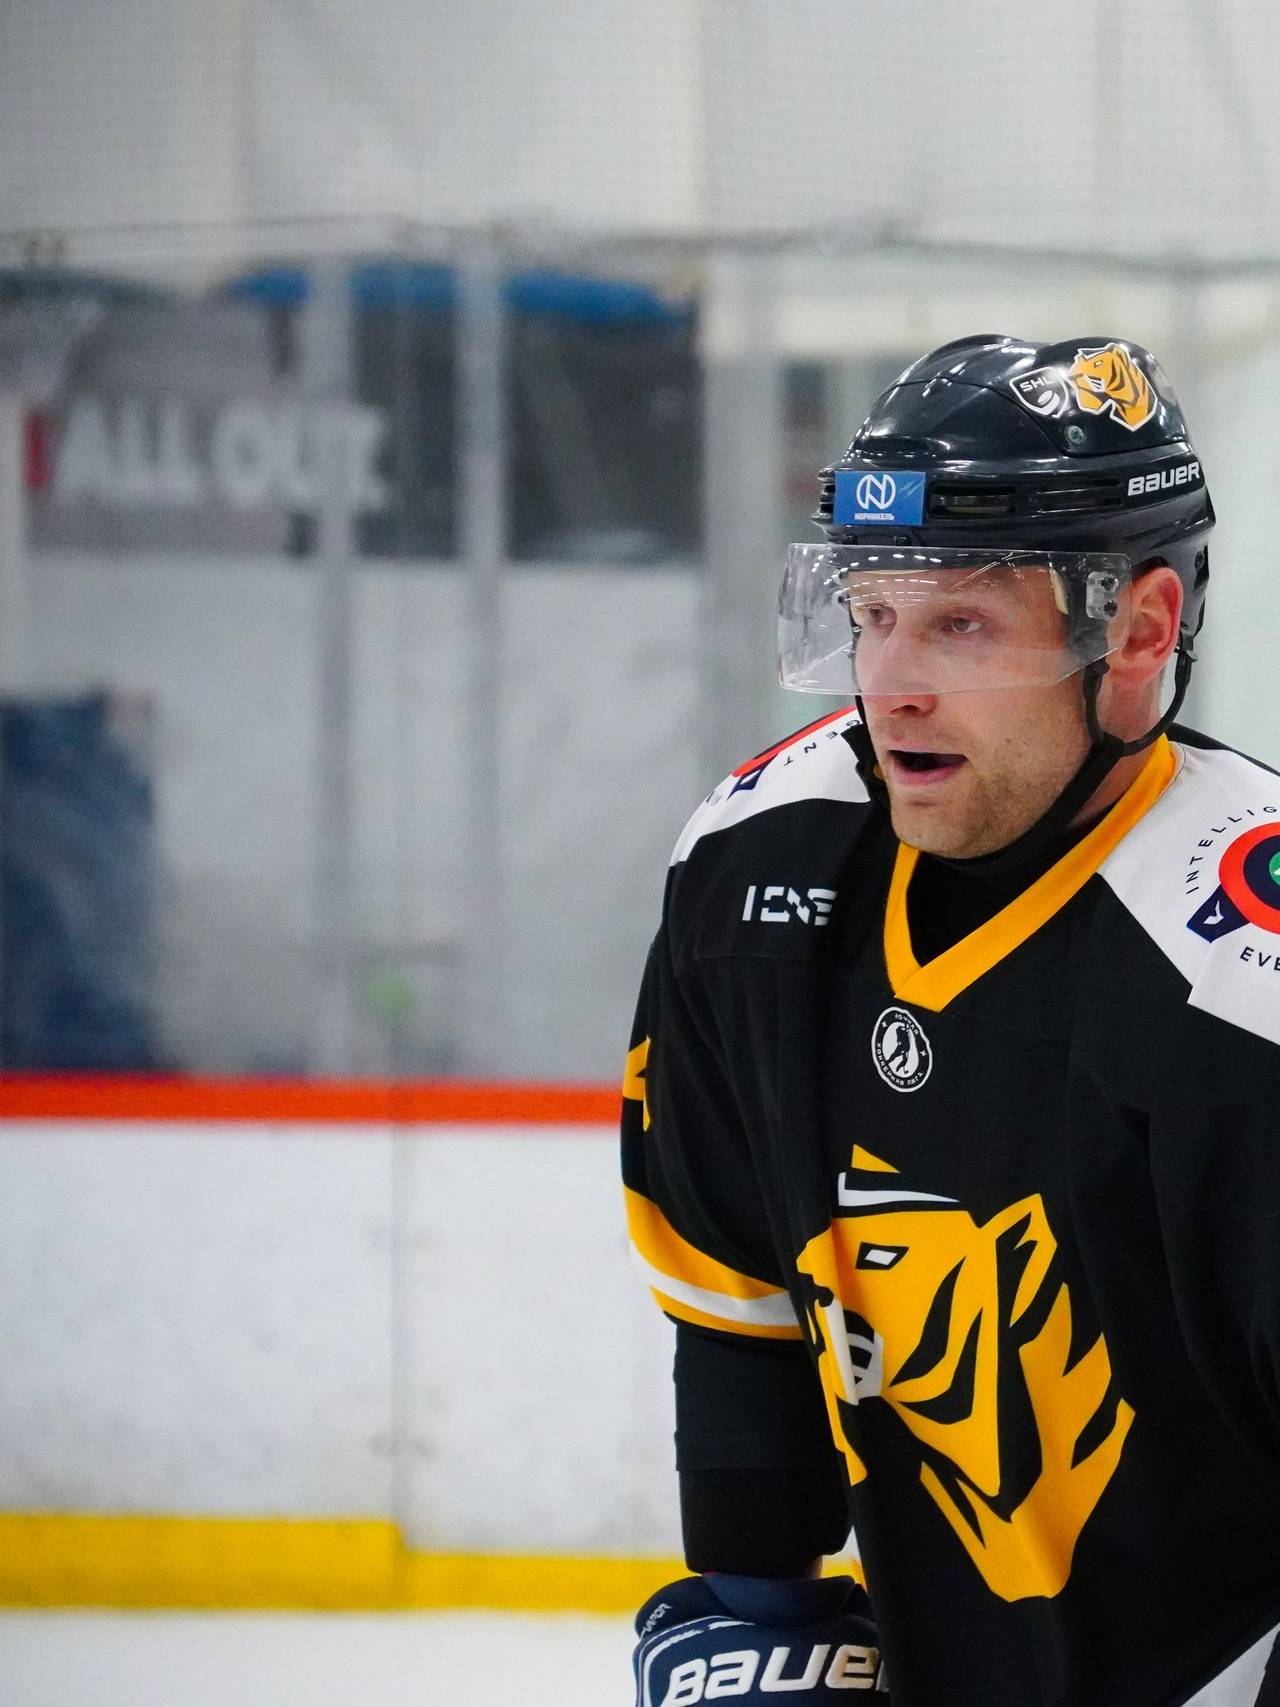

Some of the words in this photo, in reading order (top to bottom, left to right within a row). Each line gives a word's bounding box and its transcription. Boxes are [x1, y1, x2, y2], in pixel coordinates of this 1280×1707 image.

[1020, 376, 1055, 393] SHL
[1127, 461, 1201, 497] BAUER
[660, 1644, 890, 1707] BAUE
